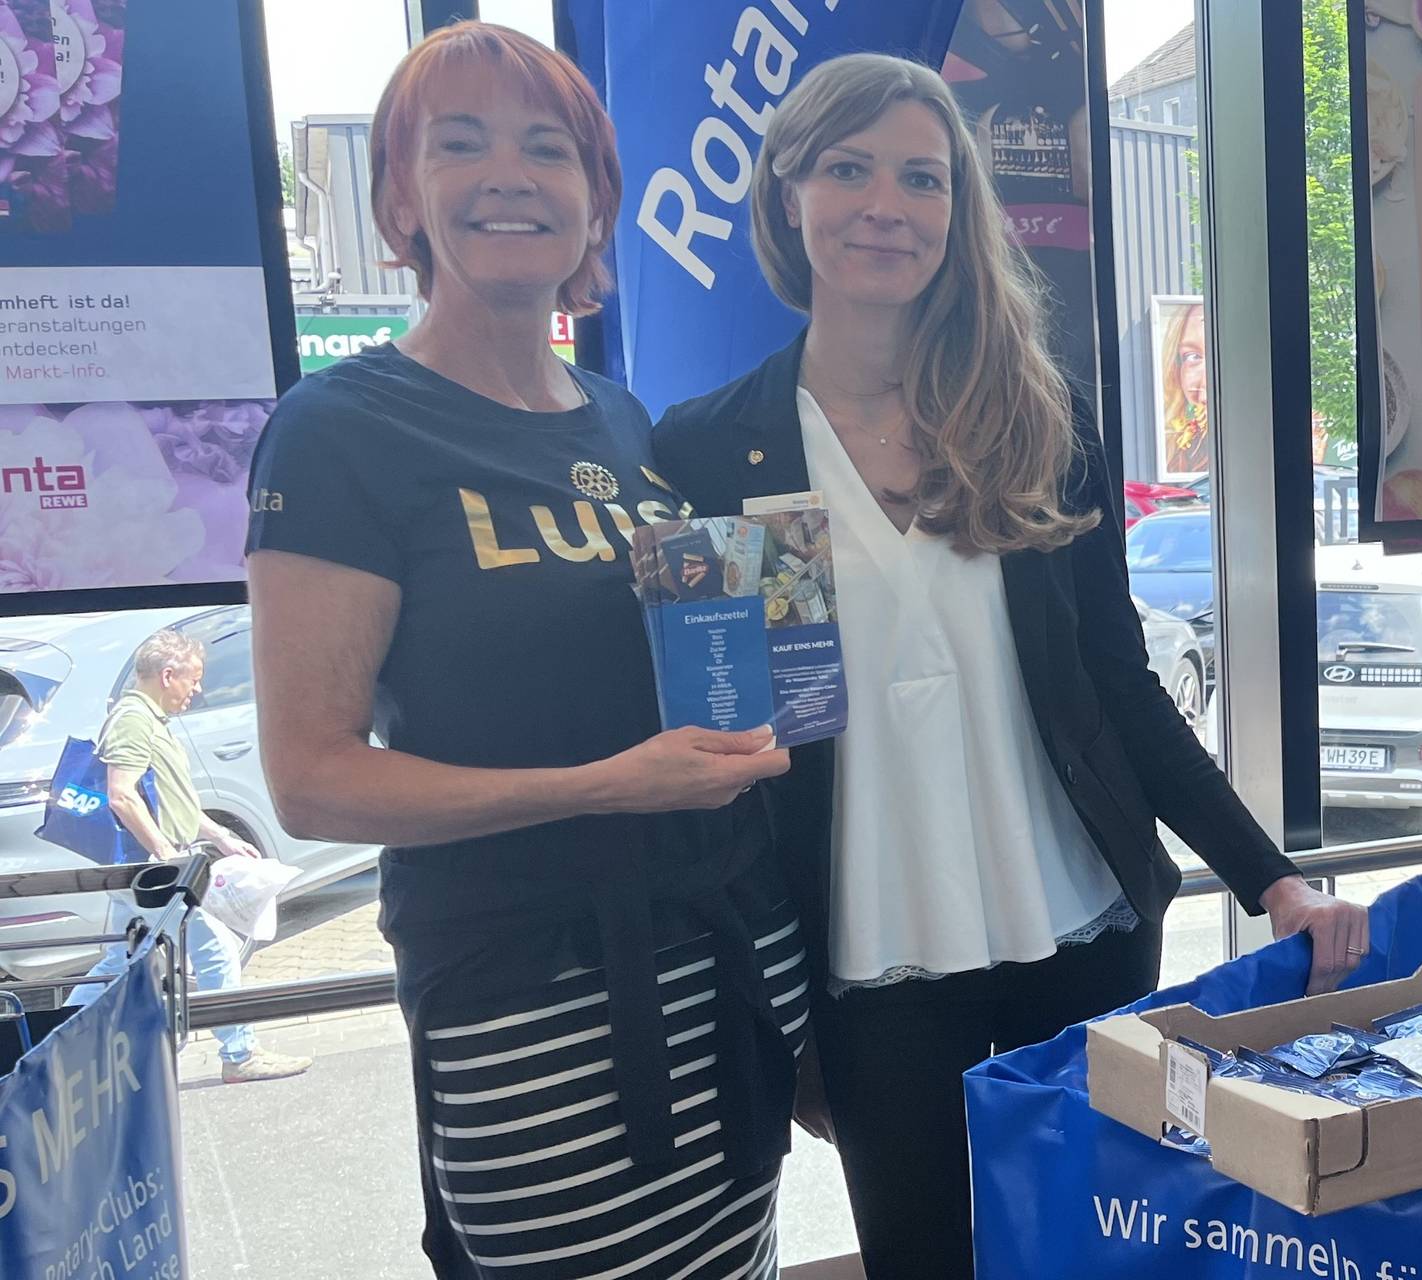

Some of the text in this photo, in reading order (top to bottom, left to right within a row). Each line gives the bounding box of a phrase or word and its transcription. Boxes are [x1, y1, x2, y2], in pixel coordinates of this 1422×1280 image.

[636, 0, 840, 290] Rota
[69, 295, 95, 309] ist
[101, 294, 130, 309] da!
[0, 341, 97, 357] ntdecken!
[297, 327, 392, 357] napf
[2, 457, 85, 492] nta
[42, 497, 86, 507] REWE
[458, 466, 694, 570] Luis
[685, 609, 749, 625] Einkaufszettel
[57, 787, 101, 814] SAP
[32, 1031, 142, 1185] MEHR
[118, 1200, 173, 1272] Land
[1093, 1195, 1361, 1280] Wir sammeln
